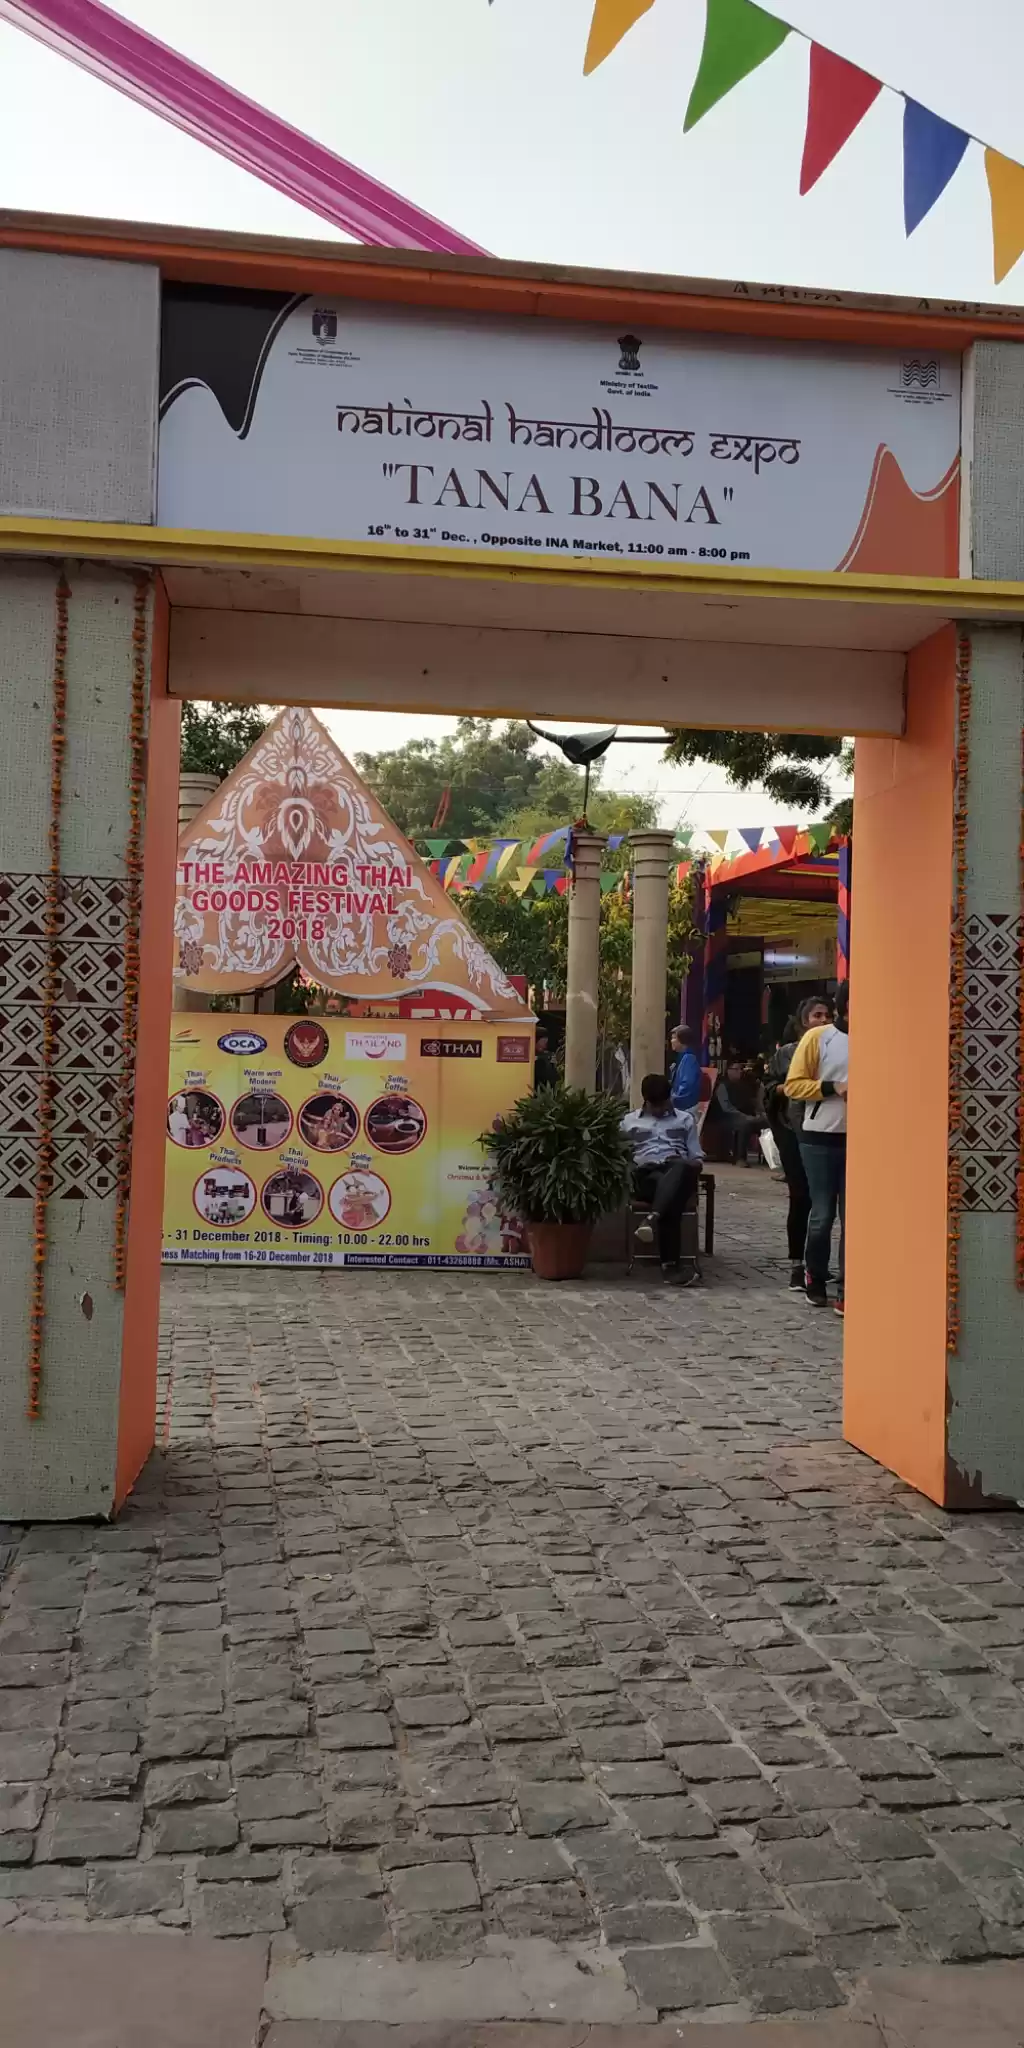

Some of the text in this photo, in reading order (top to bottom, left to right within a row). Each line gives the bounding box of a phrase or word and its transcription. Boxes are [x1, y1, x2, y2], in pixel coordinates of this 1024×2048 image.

[336, 397, 802, 475] national handloom expo
[382, 462, 735, 525] "TANA BANA"
[394, 526, 409, 538] to
[481, 533, 542, 547] Opposite
[546, 537, 569, 549] INA
[573, 538, 624, 554] Market,
[627, 542, 664, 555] 11:00
[667, 547, 688, 556] am
[699, 547, 727, 558] 8:00
[730, 550, 751, 561] pm
[179, 861, 413, 888] THE AMAZING THAI
[191, 890, 400, 916] GOODS FESTIVAL
[267, 918, 326, 941] 2018
[229, 1039, 257, 1049] OCA
[349, 1038, 402, 1048] THAILAND
[442, 1043, 480, 1054] THAI
[243, 1069, 265, 1077] Warm
[323, 1073, 339, 1082] Thai
[288, 1147, 304, 1157] Thai
[175, 1229, 188, 1241] 31
[192, 1229, 250, 1242] December
[254, 1231, 281, 1243] 2018
[292, 1232, 333, 1247] Timing:
[337, 1233, 368, 1245] 10.00
[378, 1234, 409, 1246] 22.00
[412, 1235, 430, 1246] hrs
[180, 1249, 220, 1262] Matching
[222, 1249, 242, 1260] from
[269, 1250, 311, 1262] December
[313, 1252, 334, 1263] 2018
[347, 1254, 386, 1264] Interested
[388, 1255, 418, 1264] Contact
